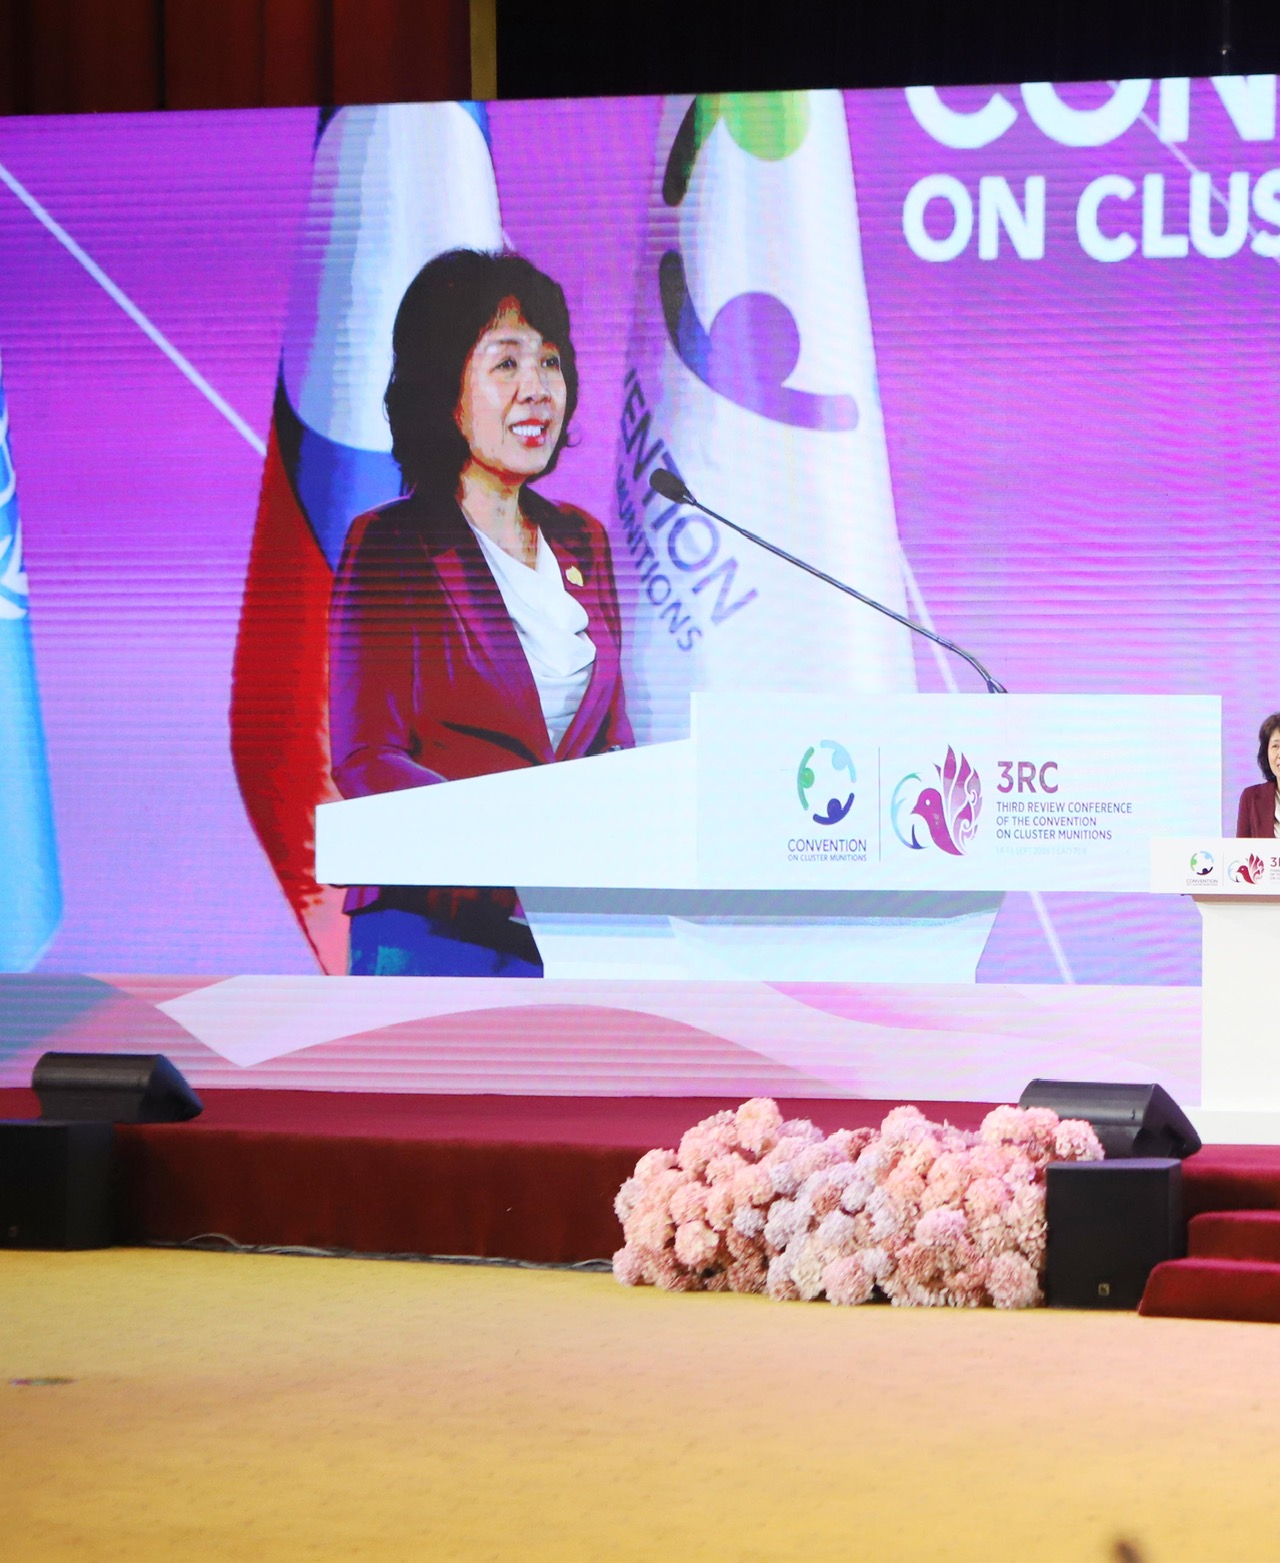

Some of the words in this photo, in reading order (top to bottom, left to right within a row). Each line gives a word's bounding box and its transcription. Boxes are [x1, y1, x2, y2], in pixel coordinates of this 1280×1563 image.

[903, 174, 1045, 262] ON
[996, 761, 1059, 794] 3RC
[996, 801, 1025, 813] THIRD
[1027, 801, 1066, 813] REVIEW
[1068, 802, 1133, 814] CONFERENCE
[996, 816, 1009, 826] OF
[1011, 816, 1030, 826] THE
[1032, 816, 1097, 827] CONVENTION
[996, 829, 1011, 839] ON
[1013, 829, 1056, 839] CLUSTER
[1058, 829, 1112, 840] MUNITIONS
[787, 838, 867, 852] CONVENTION
[800, 854, 828, 862] CLUSTER
[830, 854, 867, 862] MUNITIONS
